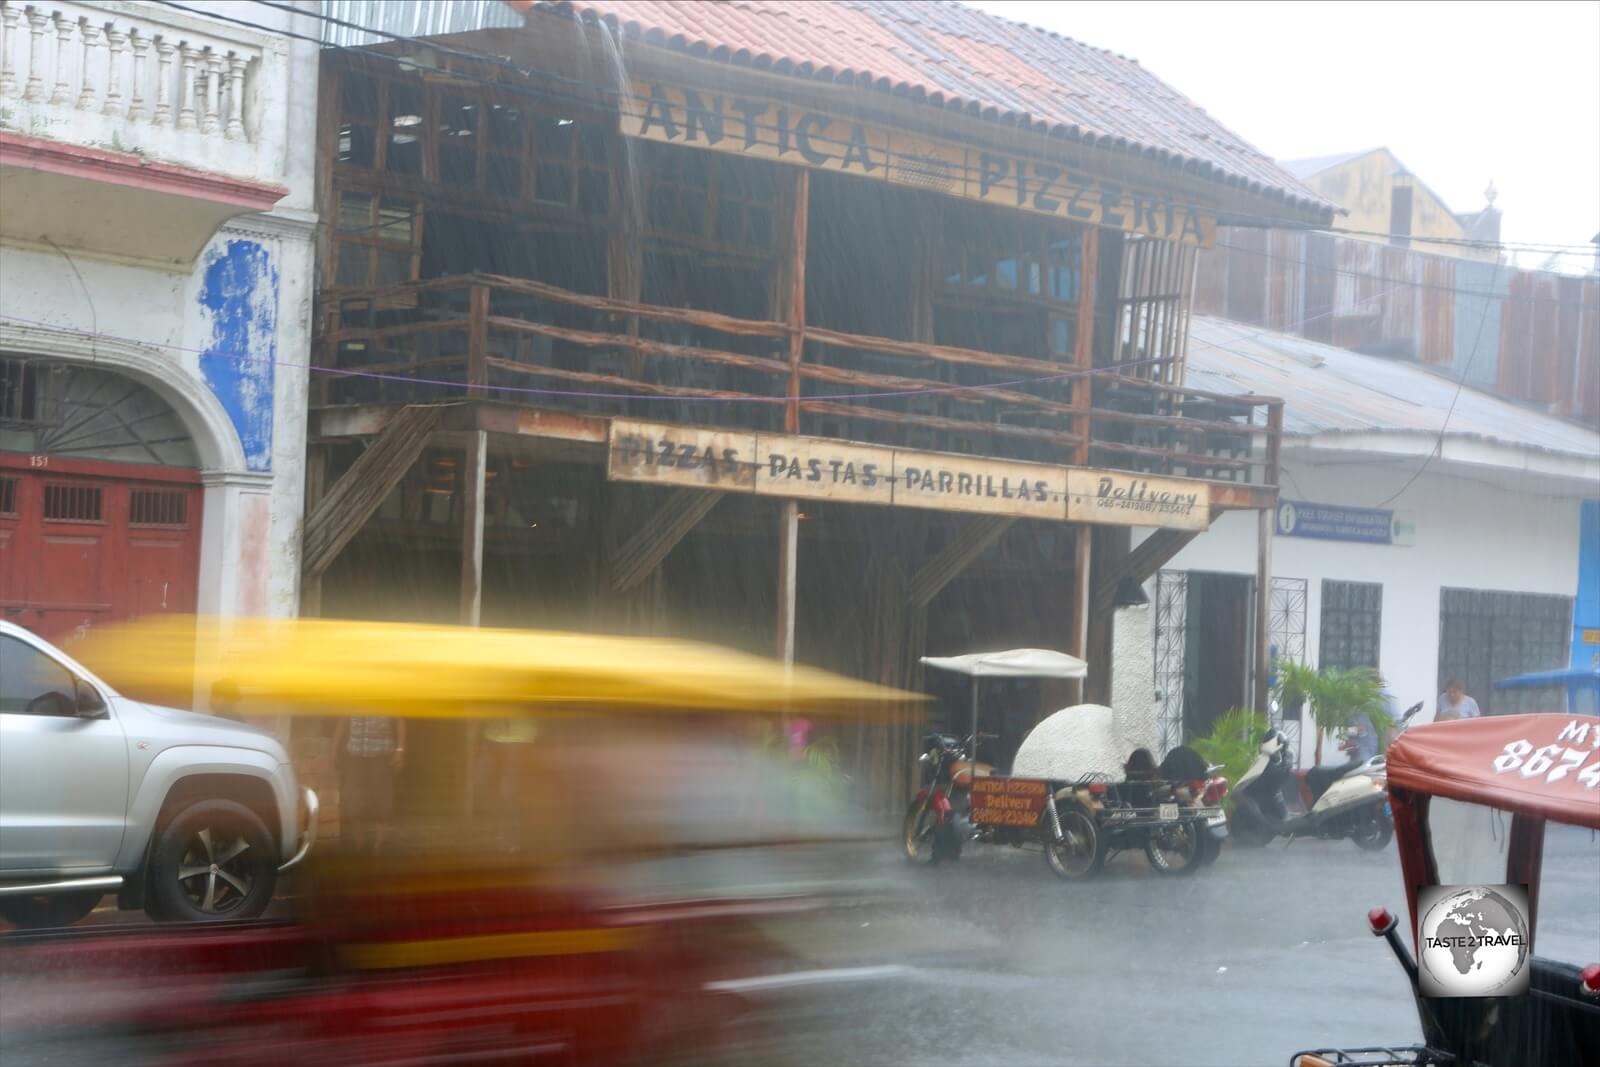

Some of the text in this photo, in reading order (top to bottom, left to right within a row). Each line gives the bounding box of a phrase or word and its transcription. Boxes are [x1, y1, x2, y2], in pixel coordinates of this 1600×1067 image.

[638, 83, 1205, 244] ANTICA PIZZERIA
[768, 453, 878, 487] PASTAS
[1096, 476, 1198, 508] Delivery
[986, 794, 1033, 810] Delivery
